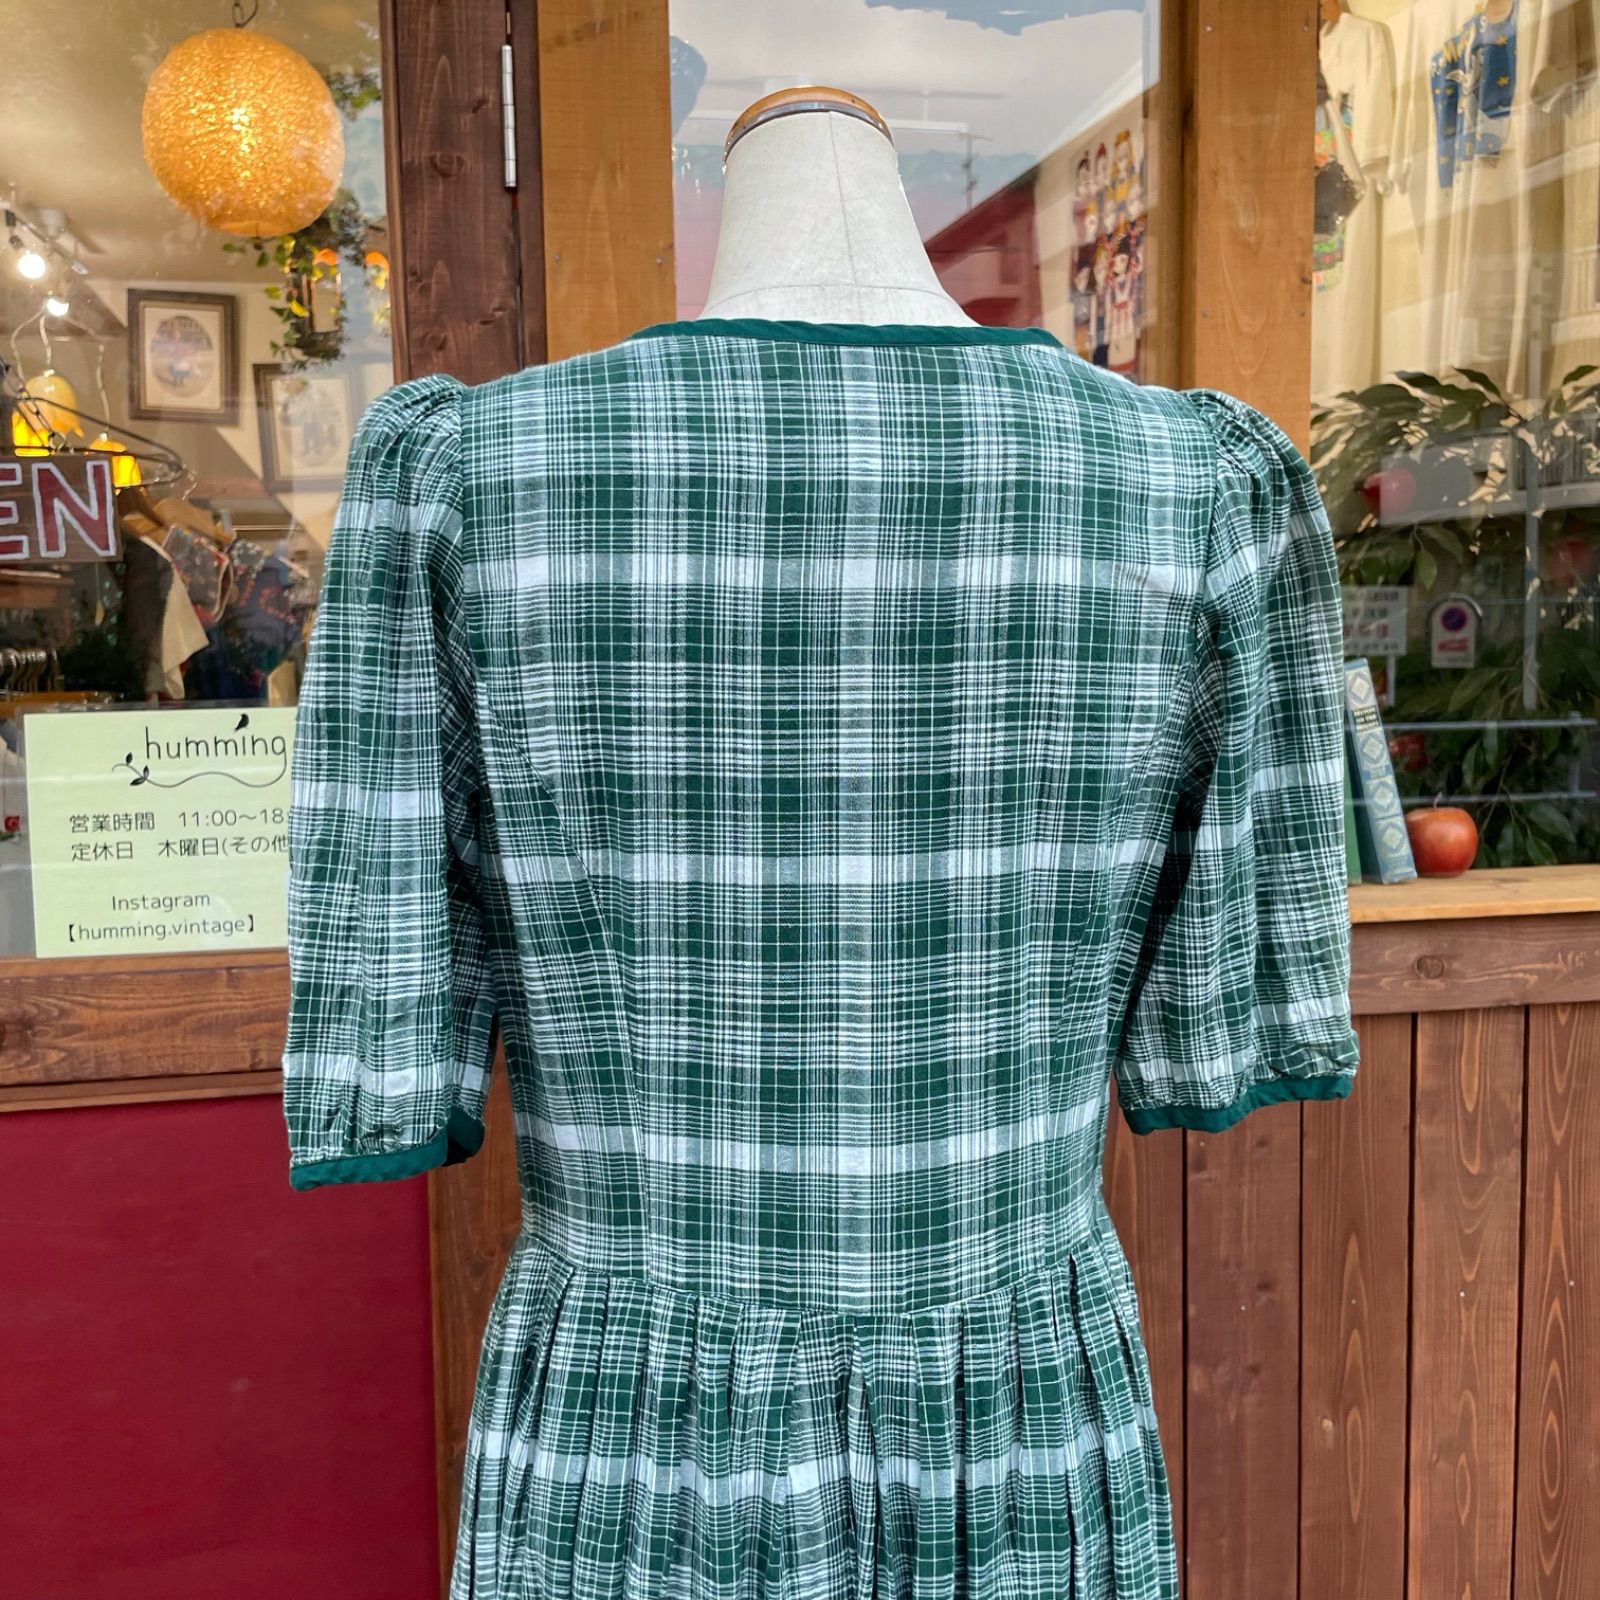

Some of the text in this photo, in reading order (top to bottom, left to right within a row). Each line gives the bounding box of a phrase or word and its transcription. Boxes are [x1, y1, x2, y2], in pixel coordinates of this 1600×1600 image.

[145, 726, 287, 770] humming
[69, 812, 156, 833] 営業時間
[71, 841, 134, 862] 定休日
[112, 893, 211, 912] Instagram
[67, 914, 255, 943] 【humming.vintage】
